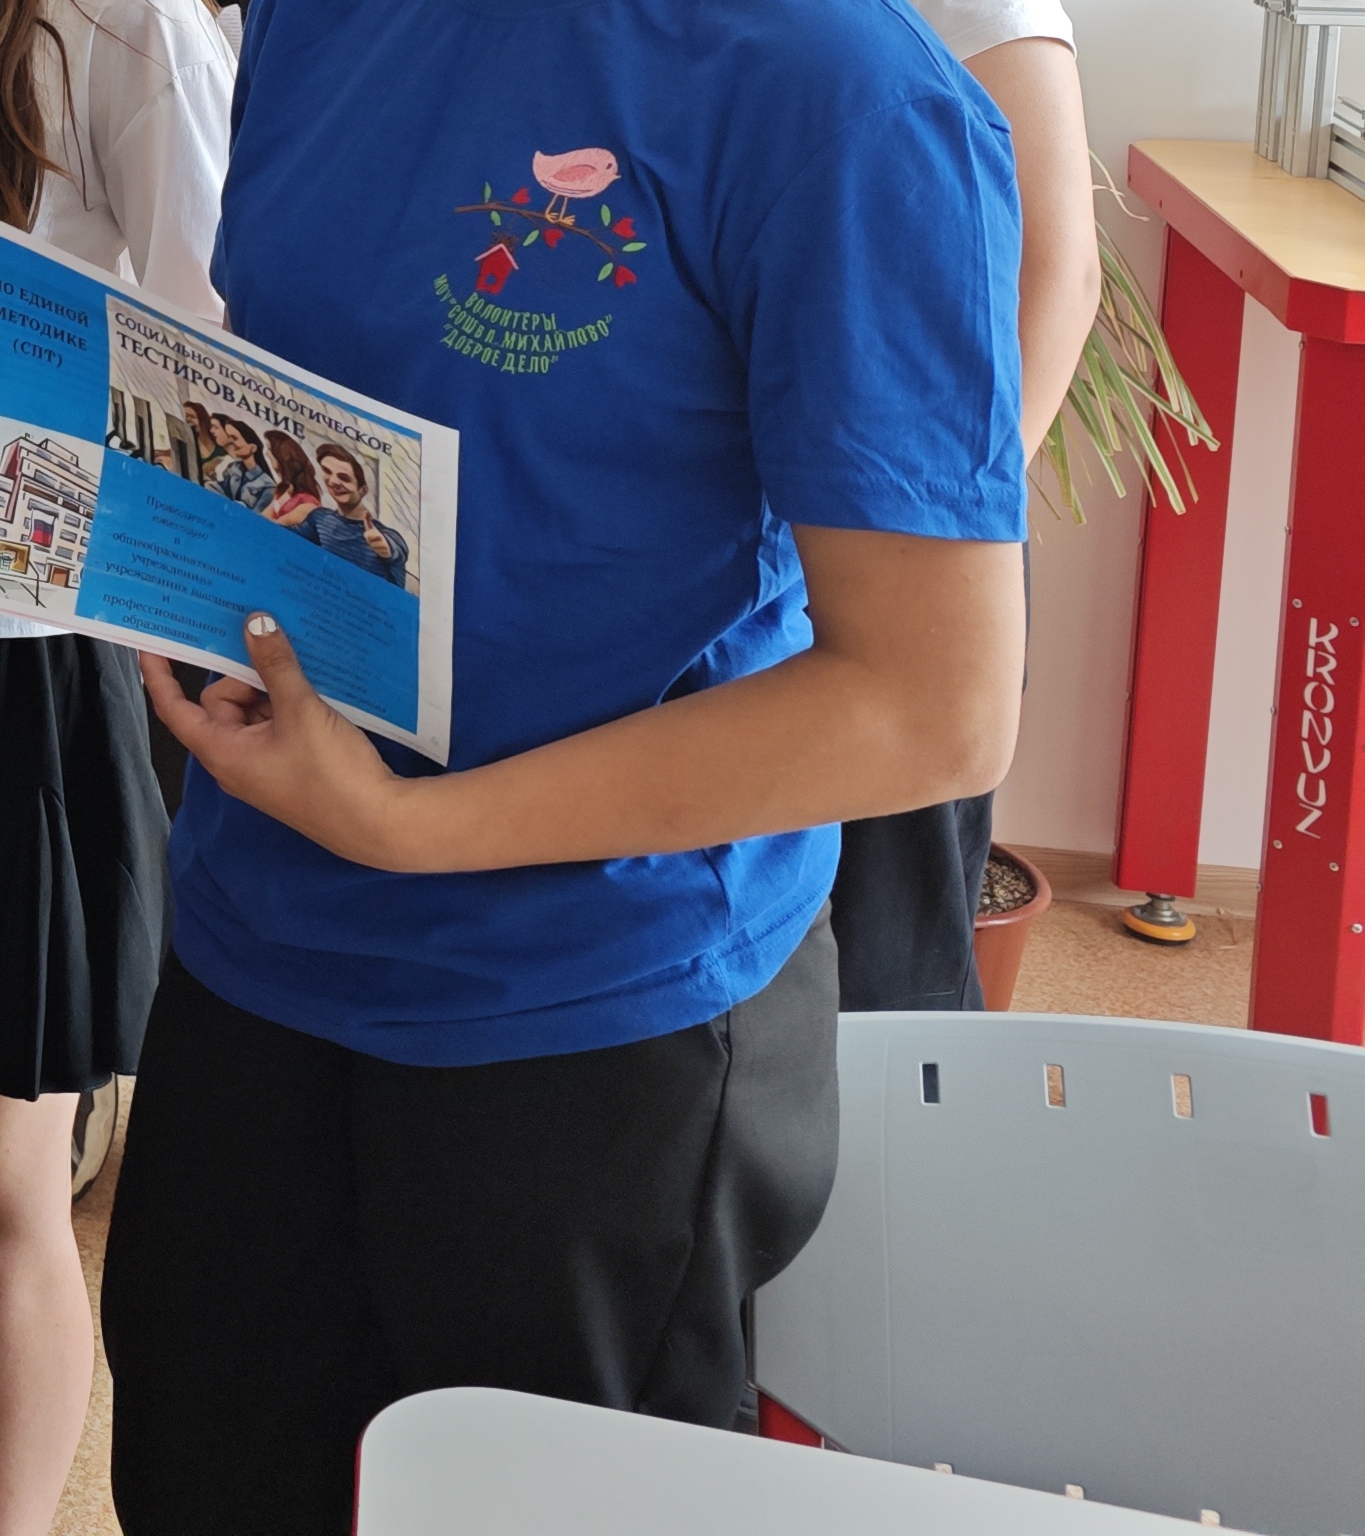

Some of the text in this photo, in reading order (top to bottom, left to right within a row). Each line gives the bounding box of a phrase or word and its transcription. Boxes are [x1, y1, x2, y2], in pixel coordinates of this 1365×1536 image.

[19, 286, 90, 328] ЕДИНОЙ
[464, 291, 557, 332] ВОЛОНТЕРЫ
[12, 338, 64, 370] (СПТ)
[115, 311, 392, 456] СОЦИАЛЬНО ПСИХОЛОГИЧЕСКОЕ
[116, 330, 307, 441] ТЕСТИРОВАНИЕ
[1295, 617, 1339, 840] KRONVUZ
